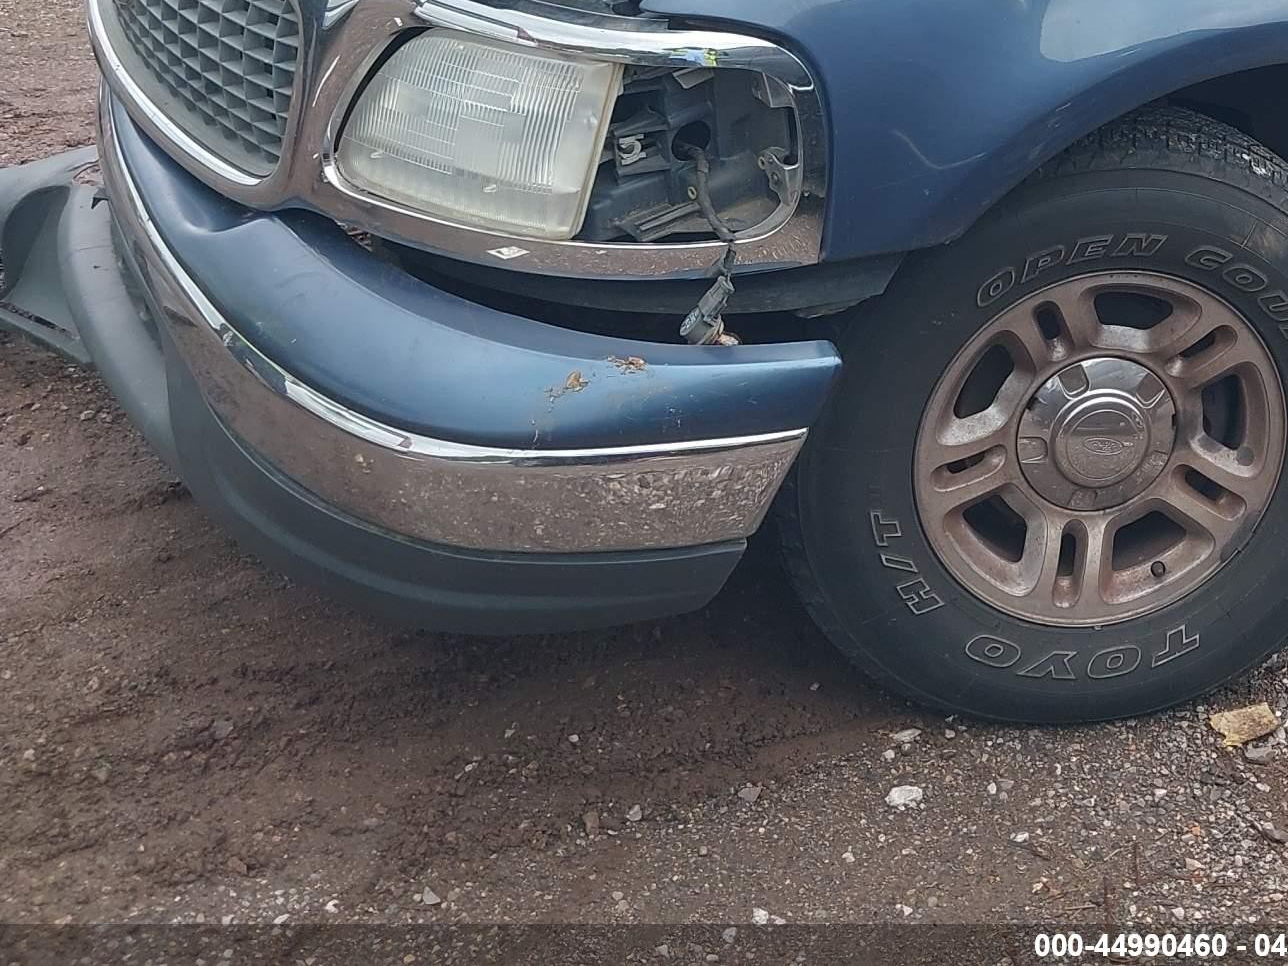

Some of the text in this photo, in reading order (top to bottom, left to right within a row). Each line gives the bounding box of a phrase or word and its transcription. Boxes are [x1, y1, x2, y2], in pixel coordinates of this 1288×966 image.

[976, 234, 1168, 309] OPEN
[870, 511, 945, 616] H/T
[964, 625, 1200, 680] TOYO
